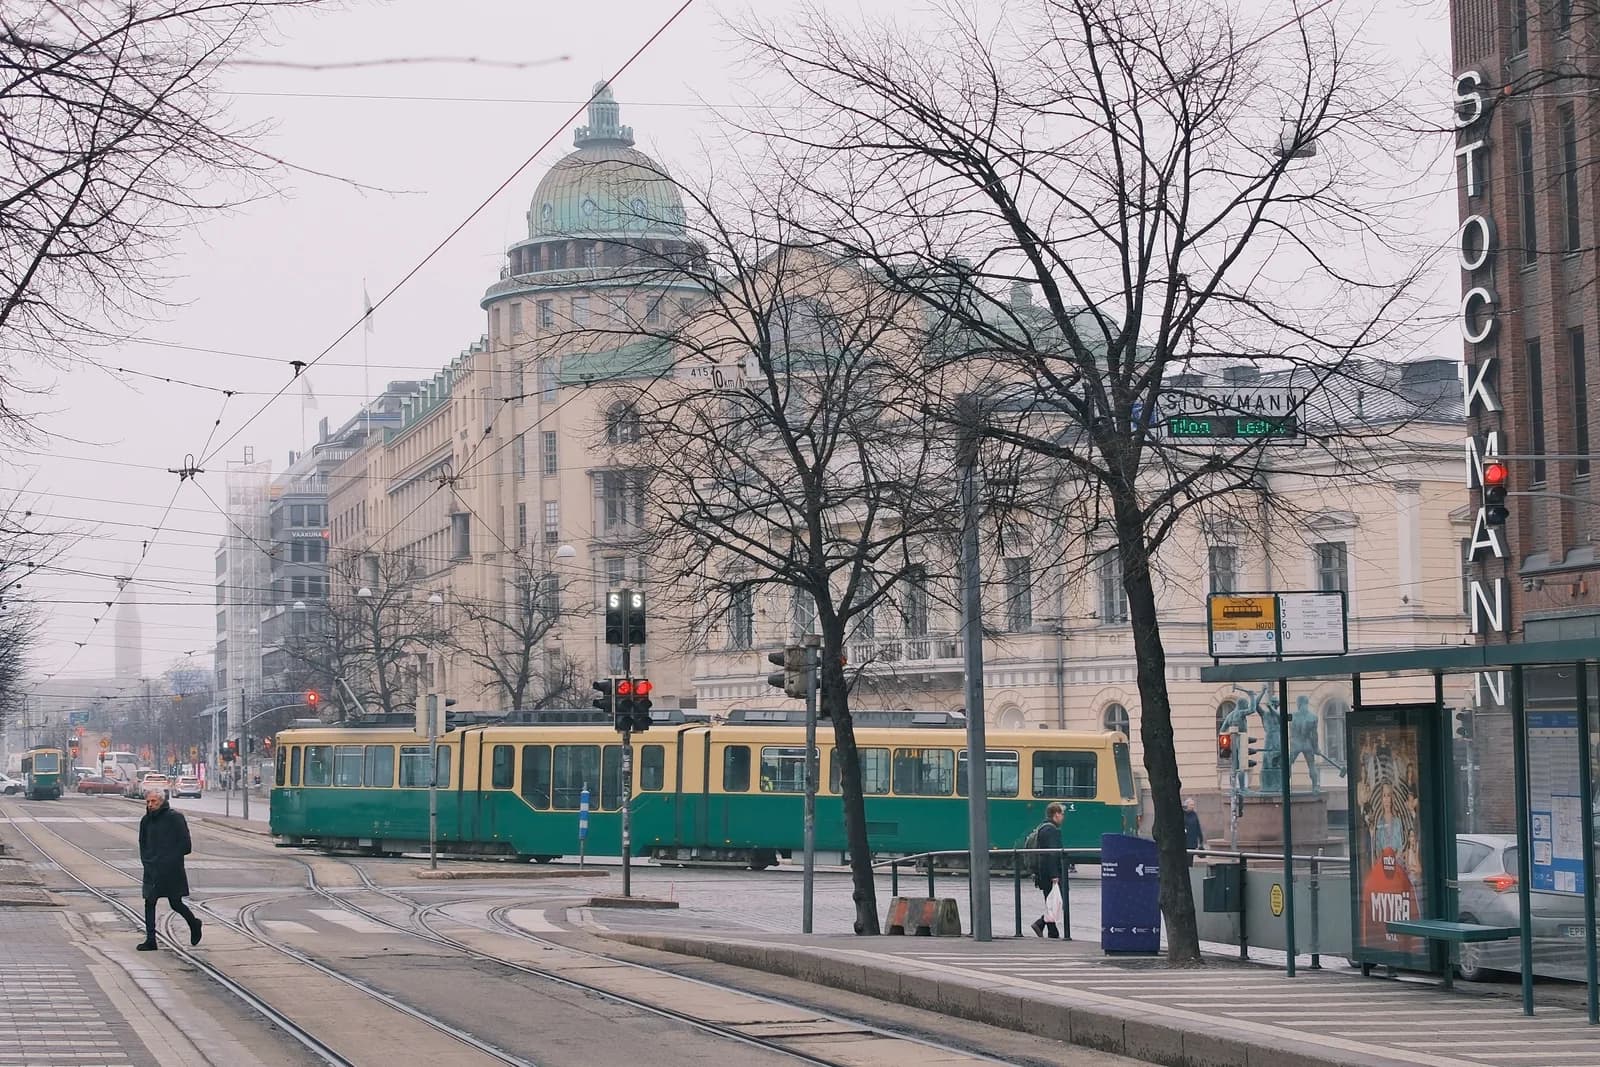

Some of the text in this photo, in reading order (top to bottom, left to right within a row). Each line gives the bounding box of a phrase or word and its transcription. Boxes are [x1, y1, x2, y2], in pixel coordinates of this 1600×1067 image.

[1282, 609, 1287, 618] 3
[1282, 620, 1287, 629] 6
[1282, 631, 1291, 640] 10
[1371, 892, 1410, 922] MYYRÄ
